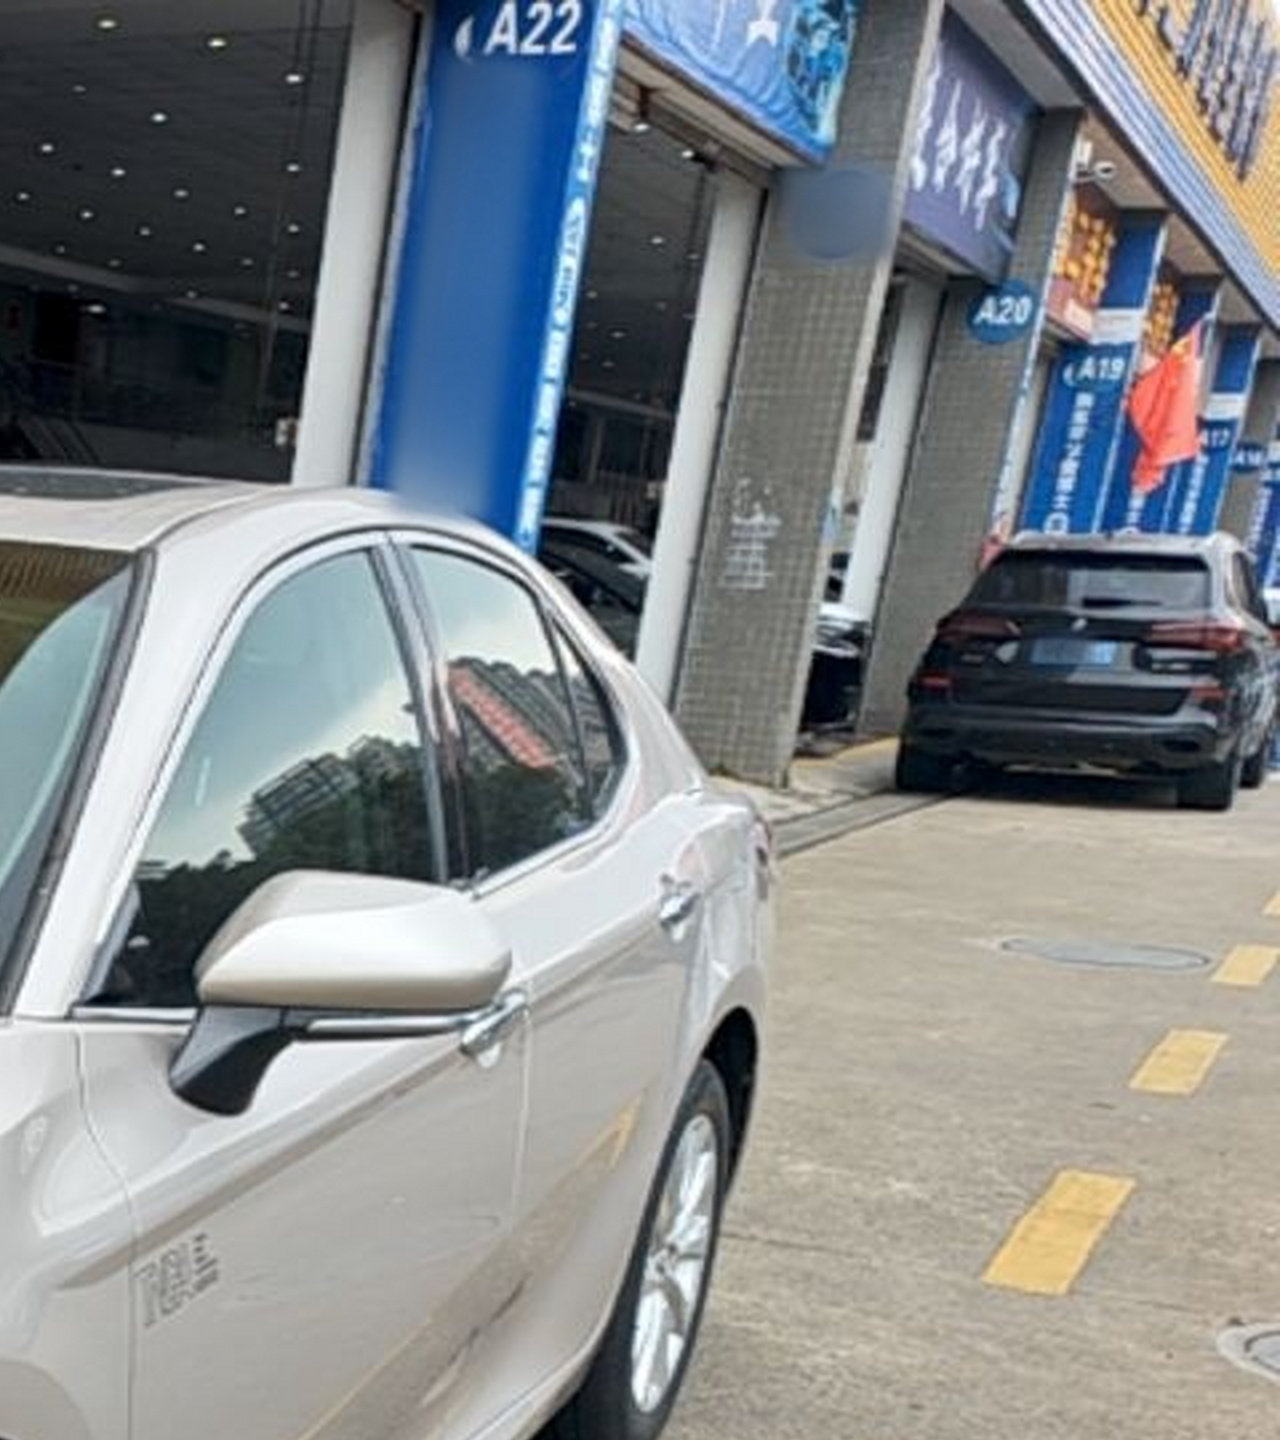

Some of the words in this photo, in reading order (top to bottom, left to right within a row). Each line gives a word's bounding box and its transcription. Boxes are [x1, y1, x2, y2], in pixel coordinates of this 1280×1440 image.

[483, 0, 582, 55] A22
[972, 295, 1033, 325] A20
[1076, 355, 1126, 380] A19
